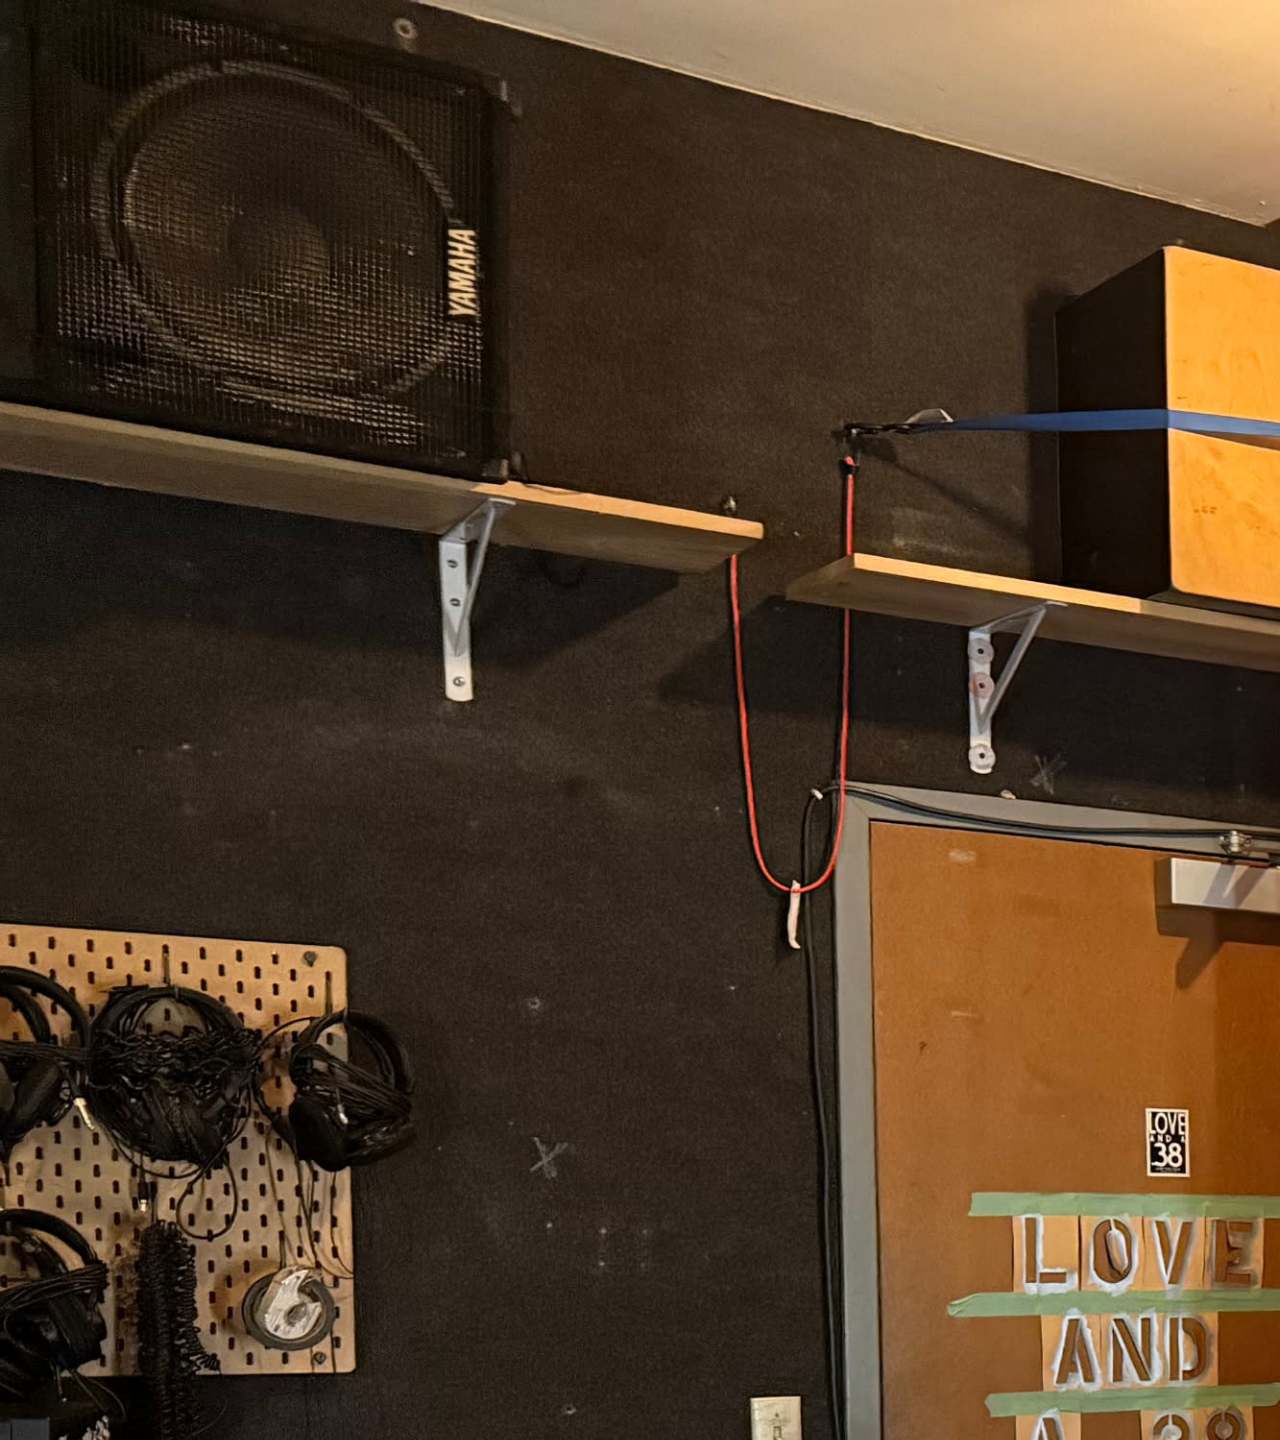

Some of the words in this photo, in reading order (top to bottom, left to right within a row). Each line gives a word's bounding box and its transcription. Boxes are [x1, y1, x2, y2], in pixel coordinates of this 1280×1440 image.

[446, 228, 478, 316] YAMAHA
[1148, 1111, 1186, 1135] LOVE
[1150, 1134, 1173, 1143] AND
[1151, 1142, 1183, 1168] 38
[1022, 1216, 1254, 1286] LOVE
[1054, 1316, 1209, 1385] AND
